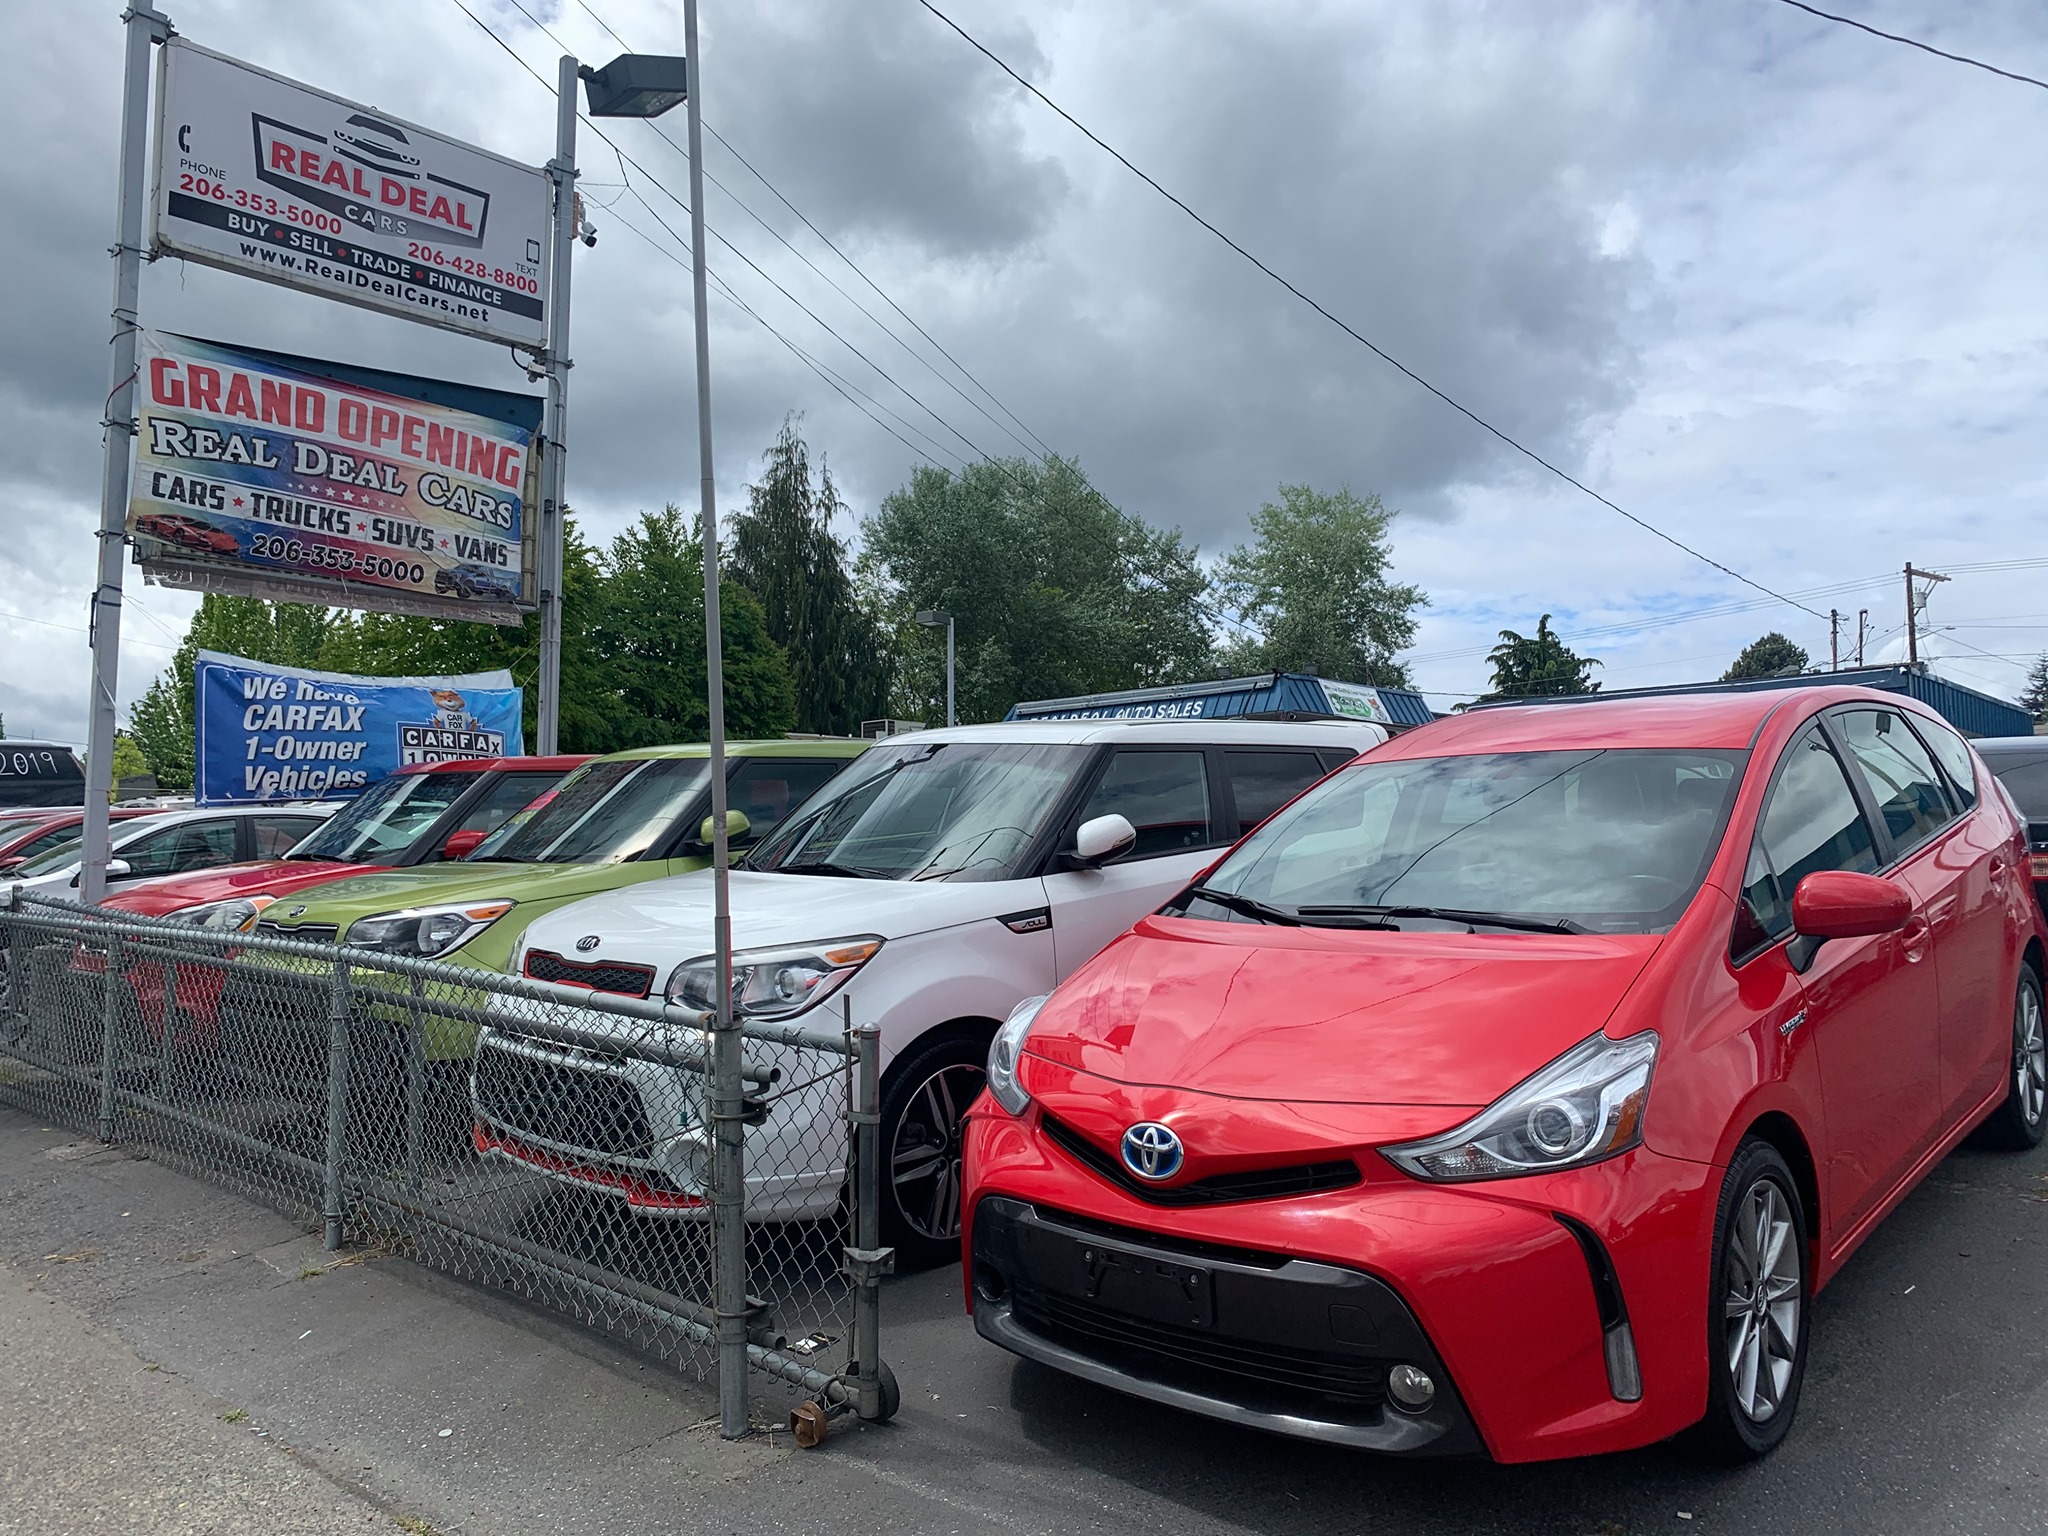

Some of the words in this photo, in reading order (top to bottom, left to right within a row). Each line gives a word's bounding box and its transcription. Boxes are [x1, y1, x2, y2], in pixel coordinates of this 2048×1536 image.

[180, 158, 227, 181] PHONE
[271, 140, 371, 199] REAL
[380, 176, 473, 231] DEAL
[179, 173, 342, 235] 206-353-5000
[344, 204, 409, 235] CARS
[227, 212, 270, 237] BUY
[289, 231, 333, 257] SELL
[351, 249, 411, 279] TRADE
[428, 272, 502, 305] FINANCE
[408, 242, 538, 294] 206-428-8800
[515, 262, 538, 277] TEXT
[240, 242, 489, 322] www.RealDealCars.net
[150, 357, 326, 433] GRAND
[338, 398, 520, 490] OPENING
[148, 416, 281, 471] REAL
[293, 439, 408, 497] DEAL
[417, 472, 513, 532] CARS
[151, 471, 226, 511] CARS
[250, 492, 351, 536] TRUCKS
[372, 517, 435, 552] SUVS
[454, 534, 508, 567] VANS
[250, 533, 425, 585] 206-353-5000
[243, 677, 287, 700] We
[243, 704, 366, 731] CARFAX
[446, 713, 463, 722] CAR
[1114, 705, 1154, 719] AUTO
[1155, 701, 1203, 719] SALES
[448, 721, 463, 729] FOX
[245, 735, 367, 760] 1-Owner
[405, 730, 500, 755] CARFAX
[0, 751, 58, 776] 2019
[245, 765, 367, 791] Vehicles
[1021, 918, 1046, 929] SOUL
